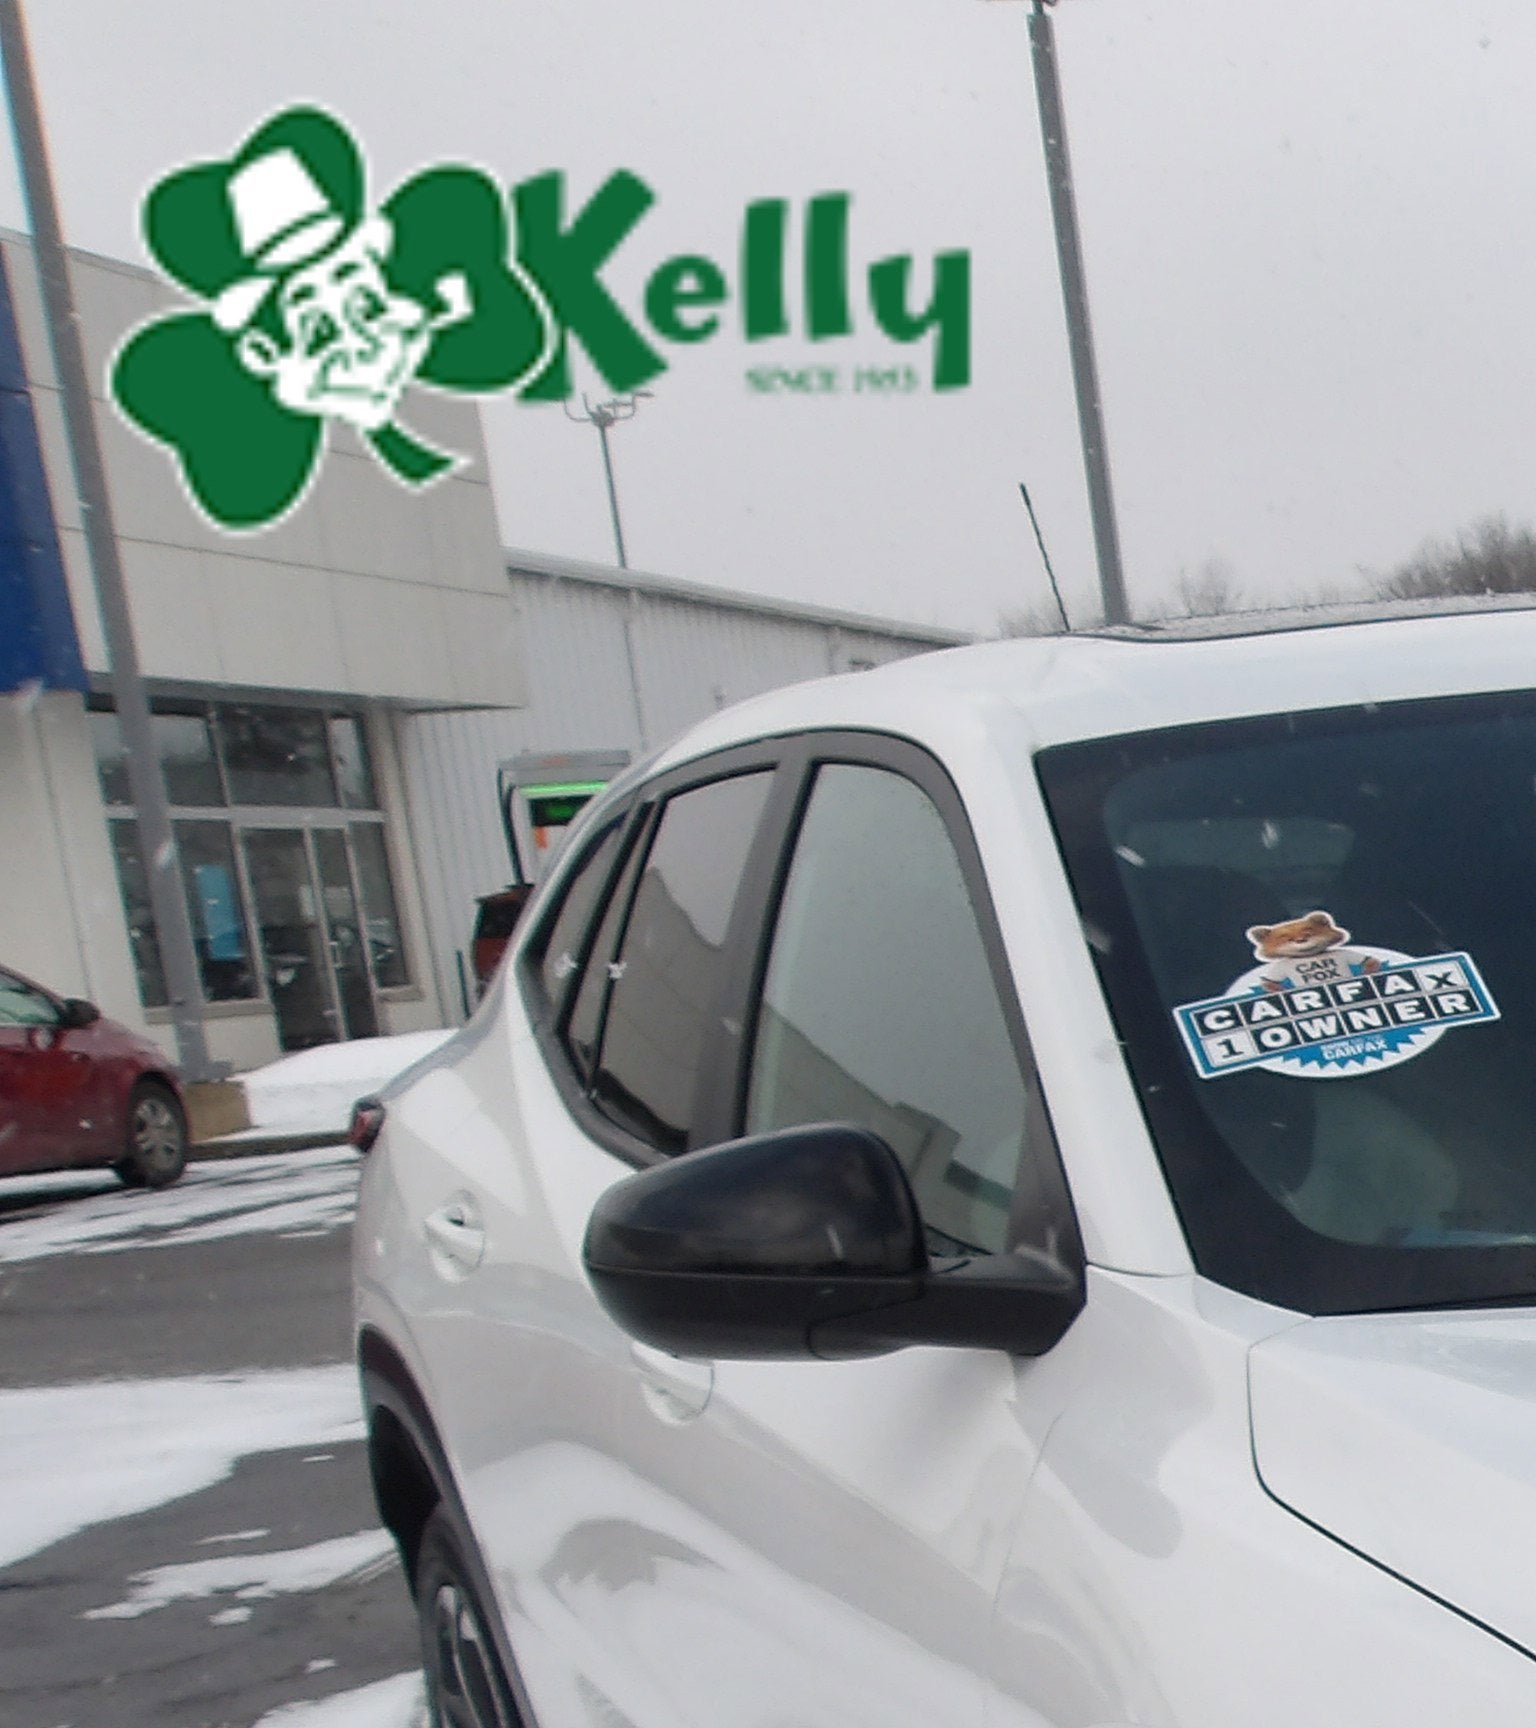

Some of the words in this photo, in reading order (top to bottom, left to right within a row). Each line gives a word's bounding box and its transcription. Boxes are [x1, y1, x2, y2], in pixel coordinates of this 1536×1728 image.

[1296, 958, 1337, 974] CAR
[1301, 969, 1341, 984] FOX
[1202, 970, 1460, 1033] CARFAX
[1219, 1036, 1245, 1061] 1
[1260, 992, 1472, 1050] OWNER
